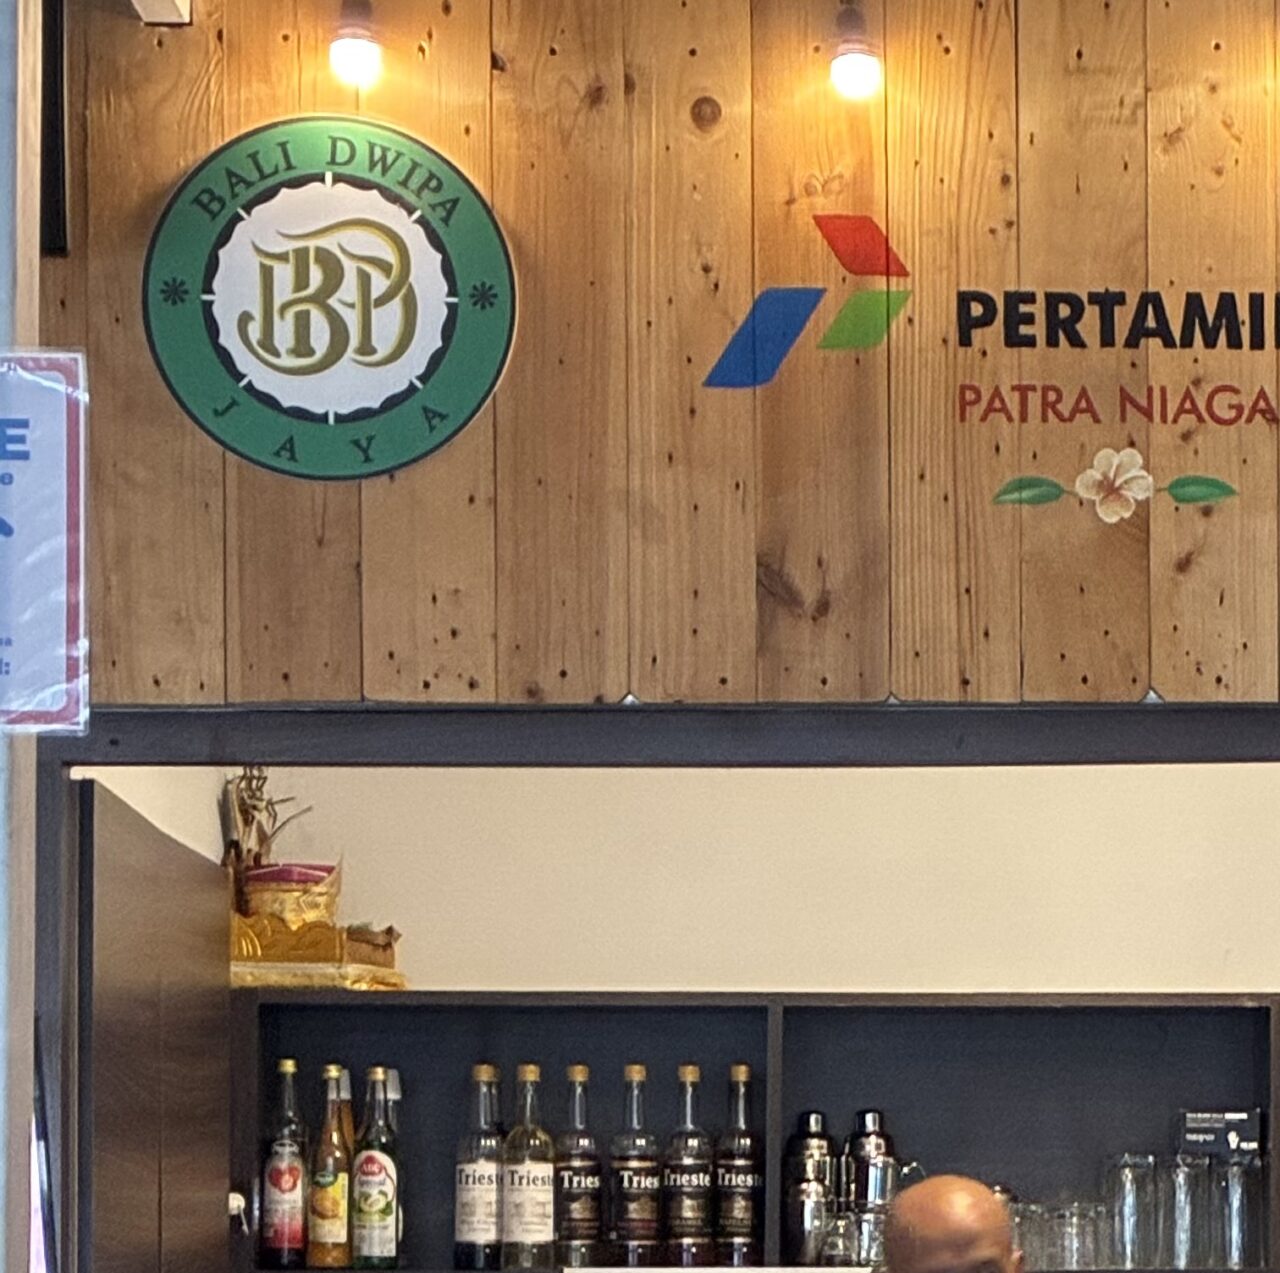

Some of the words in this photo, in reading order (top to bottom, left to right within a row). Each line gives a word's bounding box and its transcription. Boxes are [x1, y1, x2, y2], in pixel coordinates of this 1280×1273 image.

[190, 141, 299, 221] BALI
[326, 136, 461, 227] DWIPA
[213, 396, 448, 463] JAYA
[958, 384, 1101, 424] PATRA
[1119, 384, 1280, 427] NIAGA
